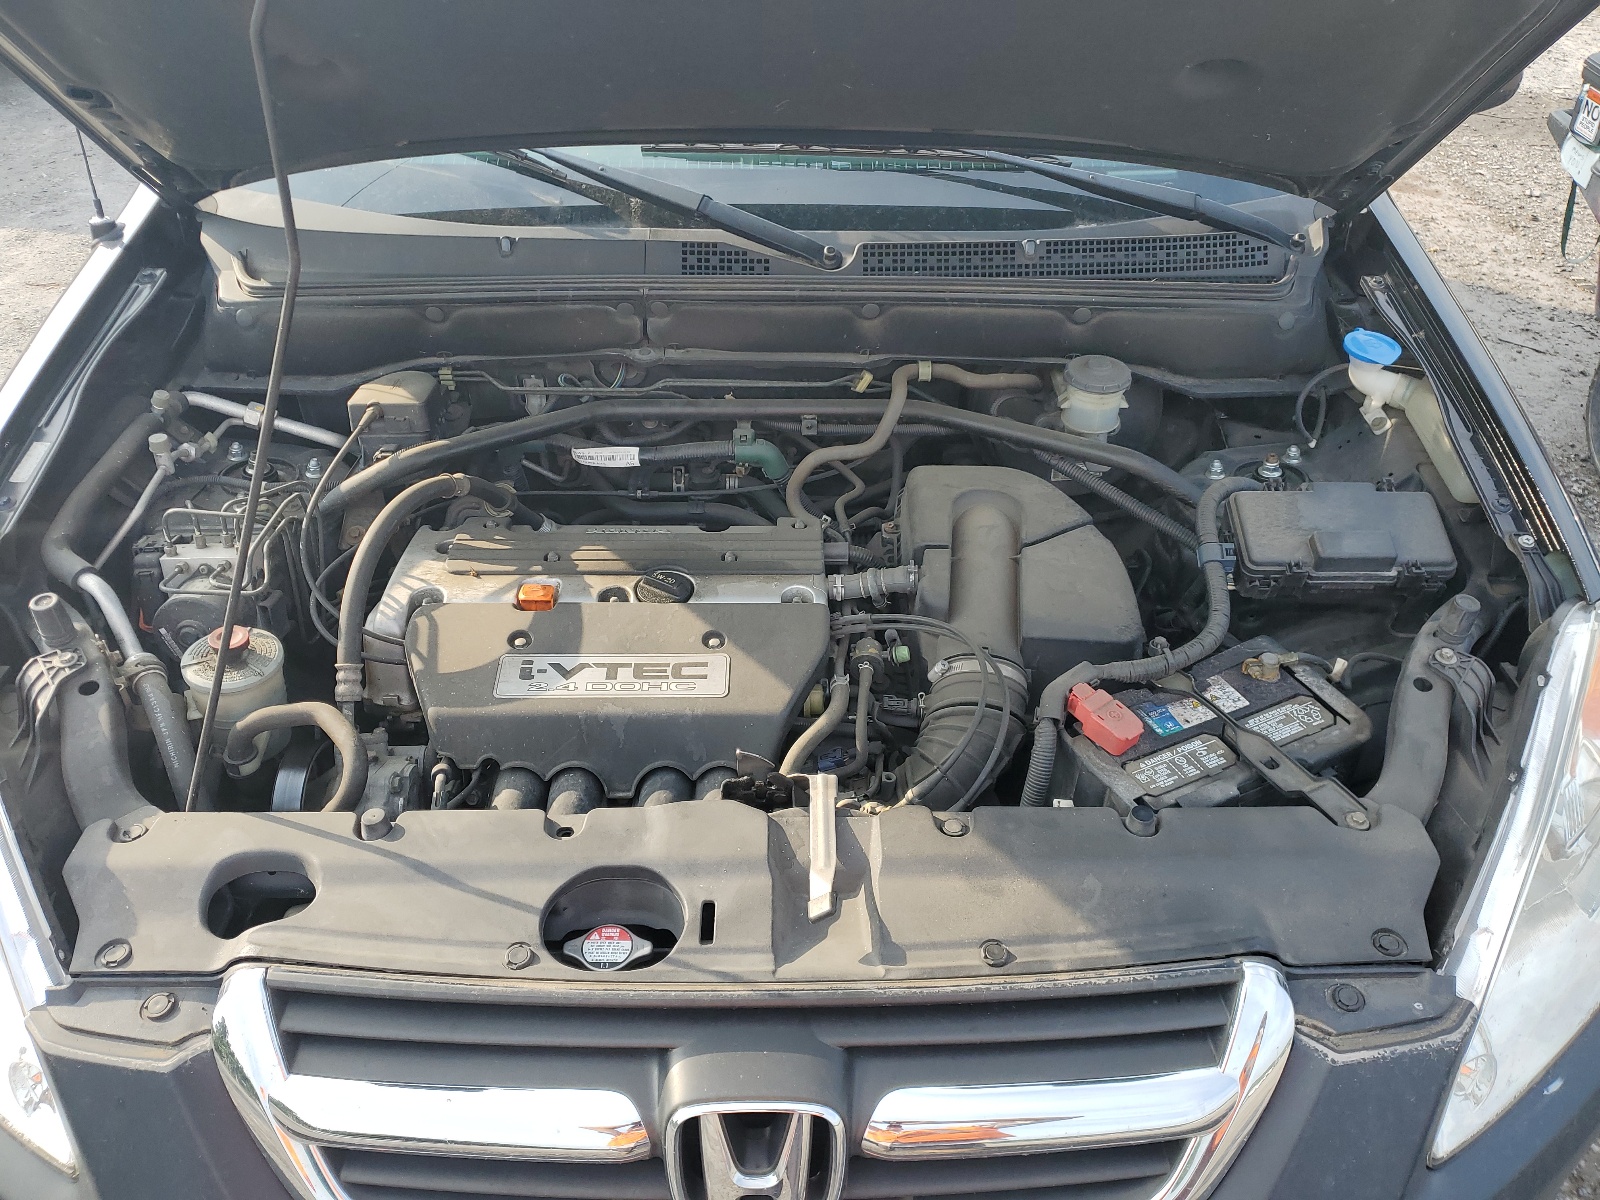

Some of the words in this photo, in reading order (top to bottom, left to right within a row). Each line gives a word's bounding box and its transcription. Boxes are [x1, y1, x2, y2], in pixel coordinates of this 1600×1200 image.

[1582, 100, 1600, 121] NO
[1579, 121, 1594, 133] PEOPLE
[518, 659, 709, 681] i-VTEC
[527, 681, 578, 692] 2.4
[585, 681, 698, 692] DOHC
[165, 738, 180, 768] NICHIRIN
[1145, 751, 1173, 766] DANGER
[1177, 740, 1203, 753] POISON
